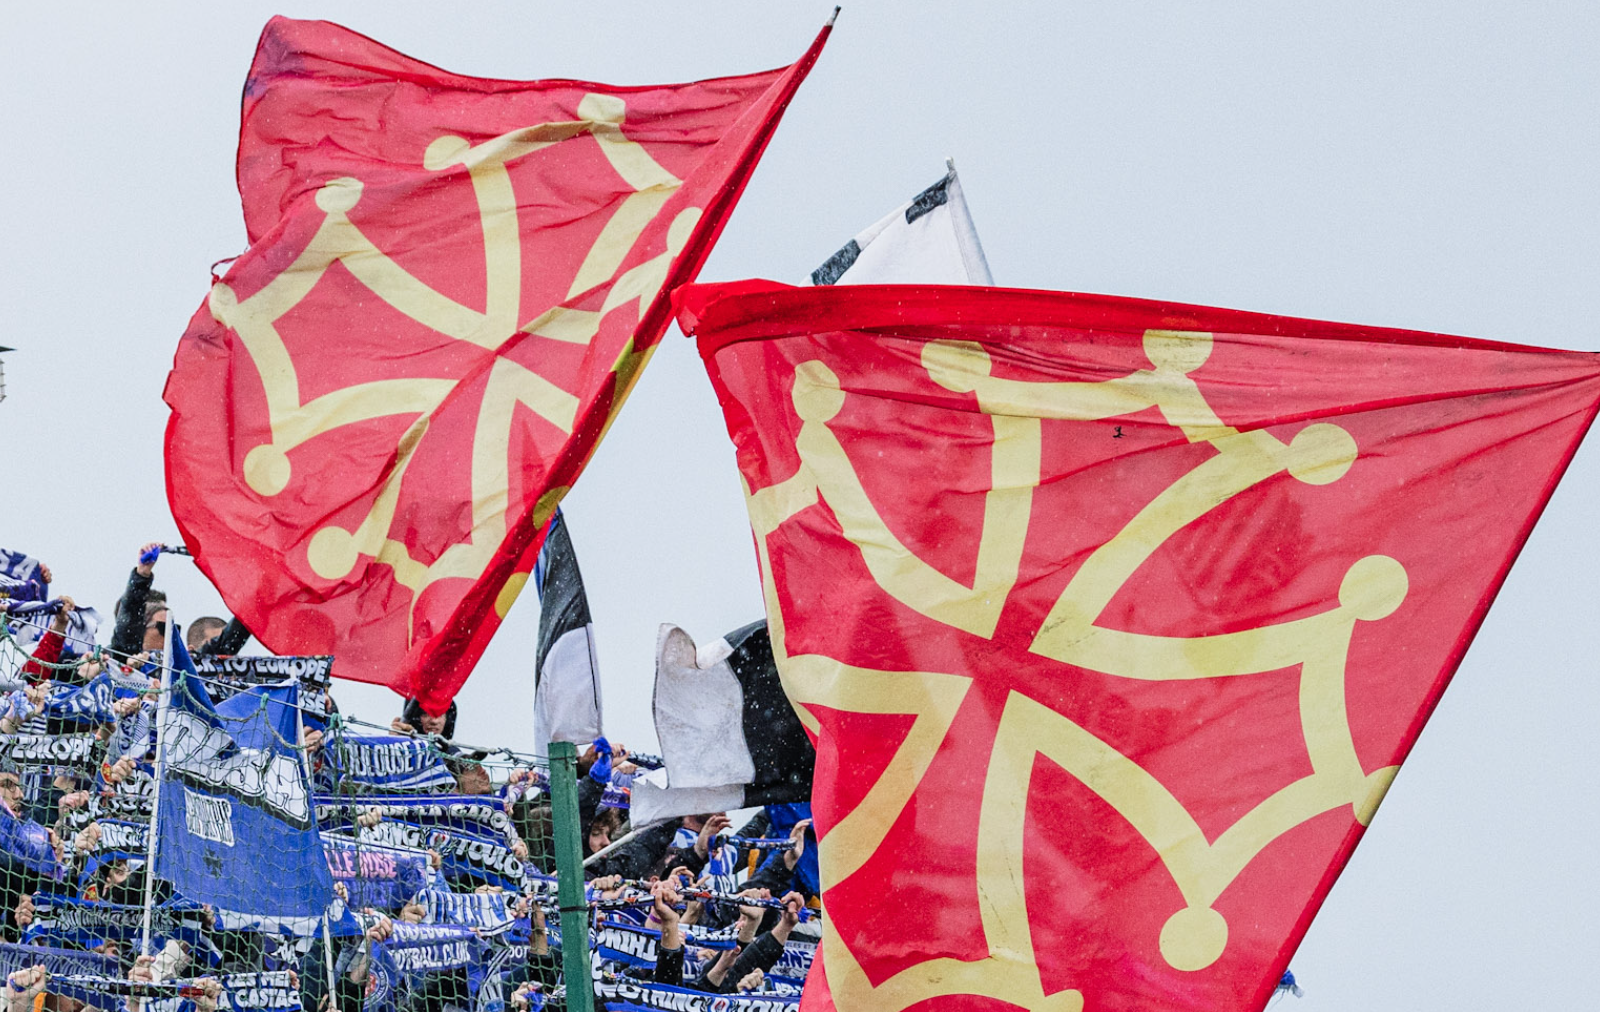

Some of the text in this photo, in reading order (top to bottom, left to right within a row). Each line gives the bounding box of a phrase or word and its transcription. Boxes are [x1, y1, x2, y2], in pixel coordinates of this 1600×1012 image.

[255, 659, 329, 683] EUROPE
[324, 849, 357, 878] LLE
[455, 838, 525, 879] TOULO
